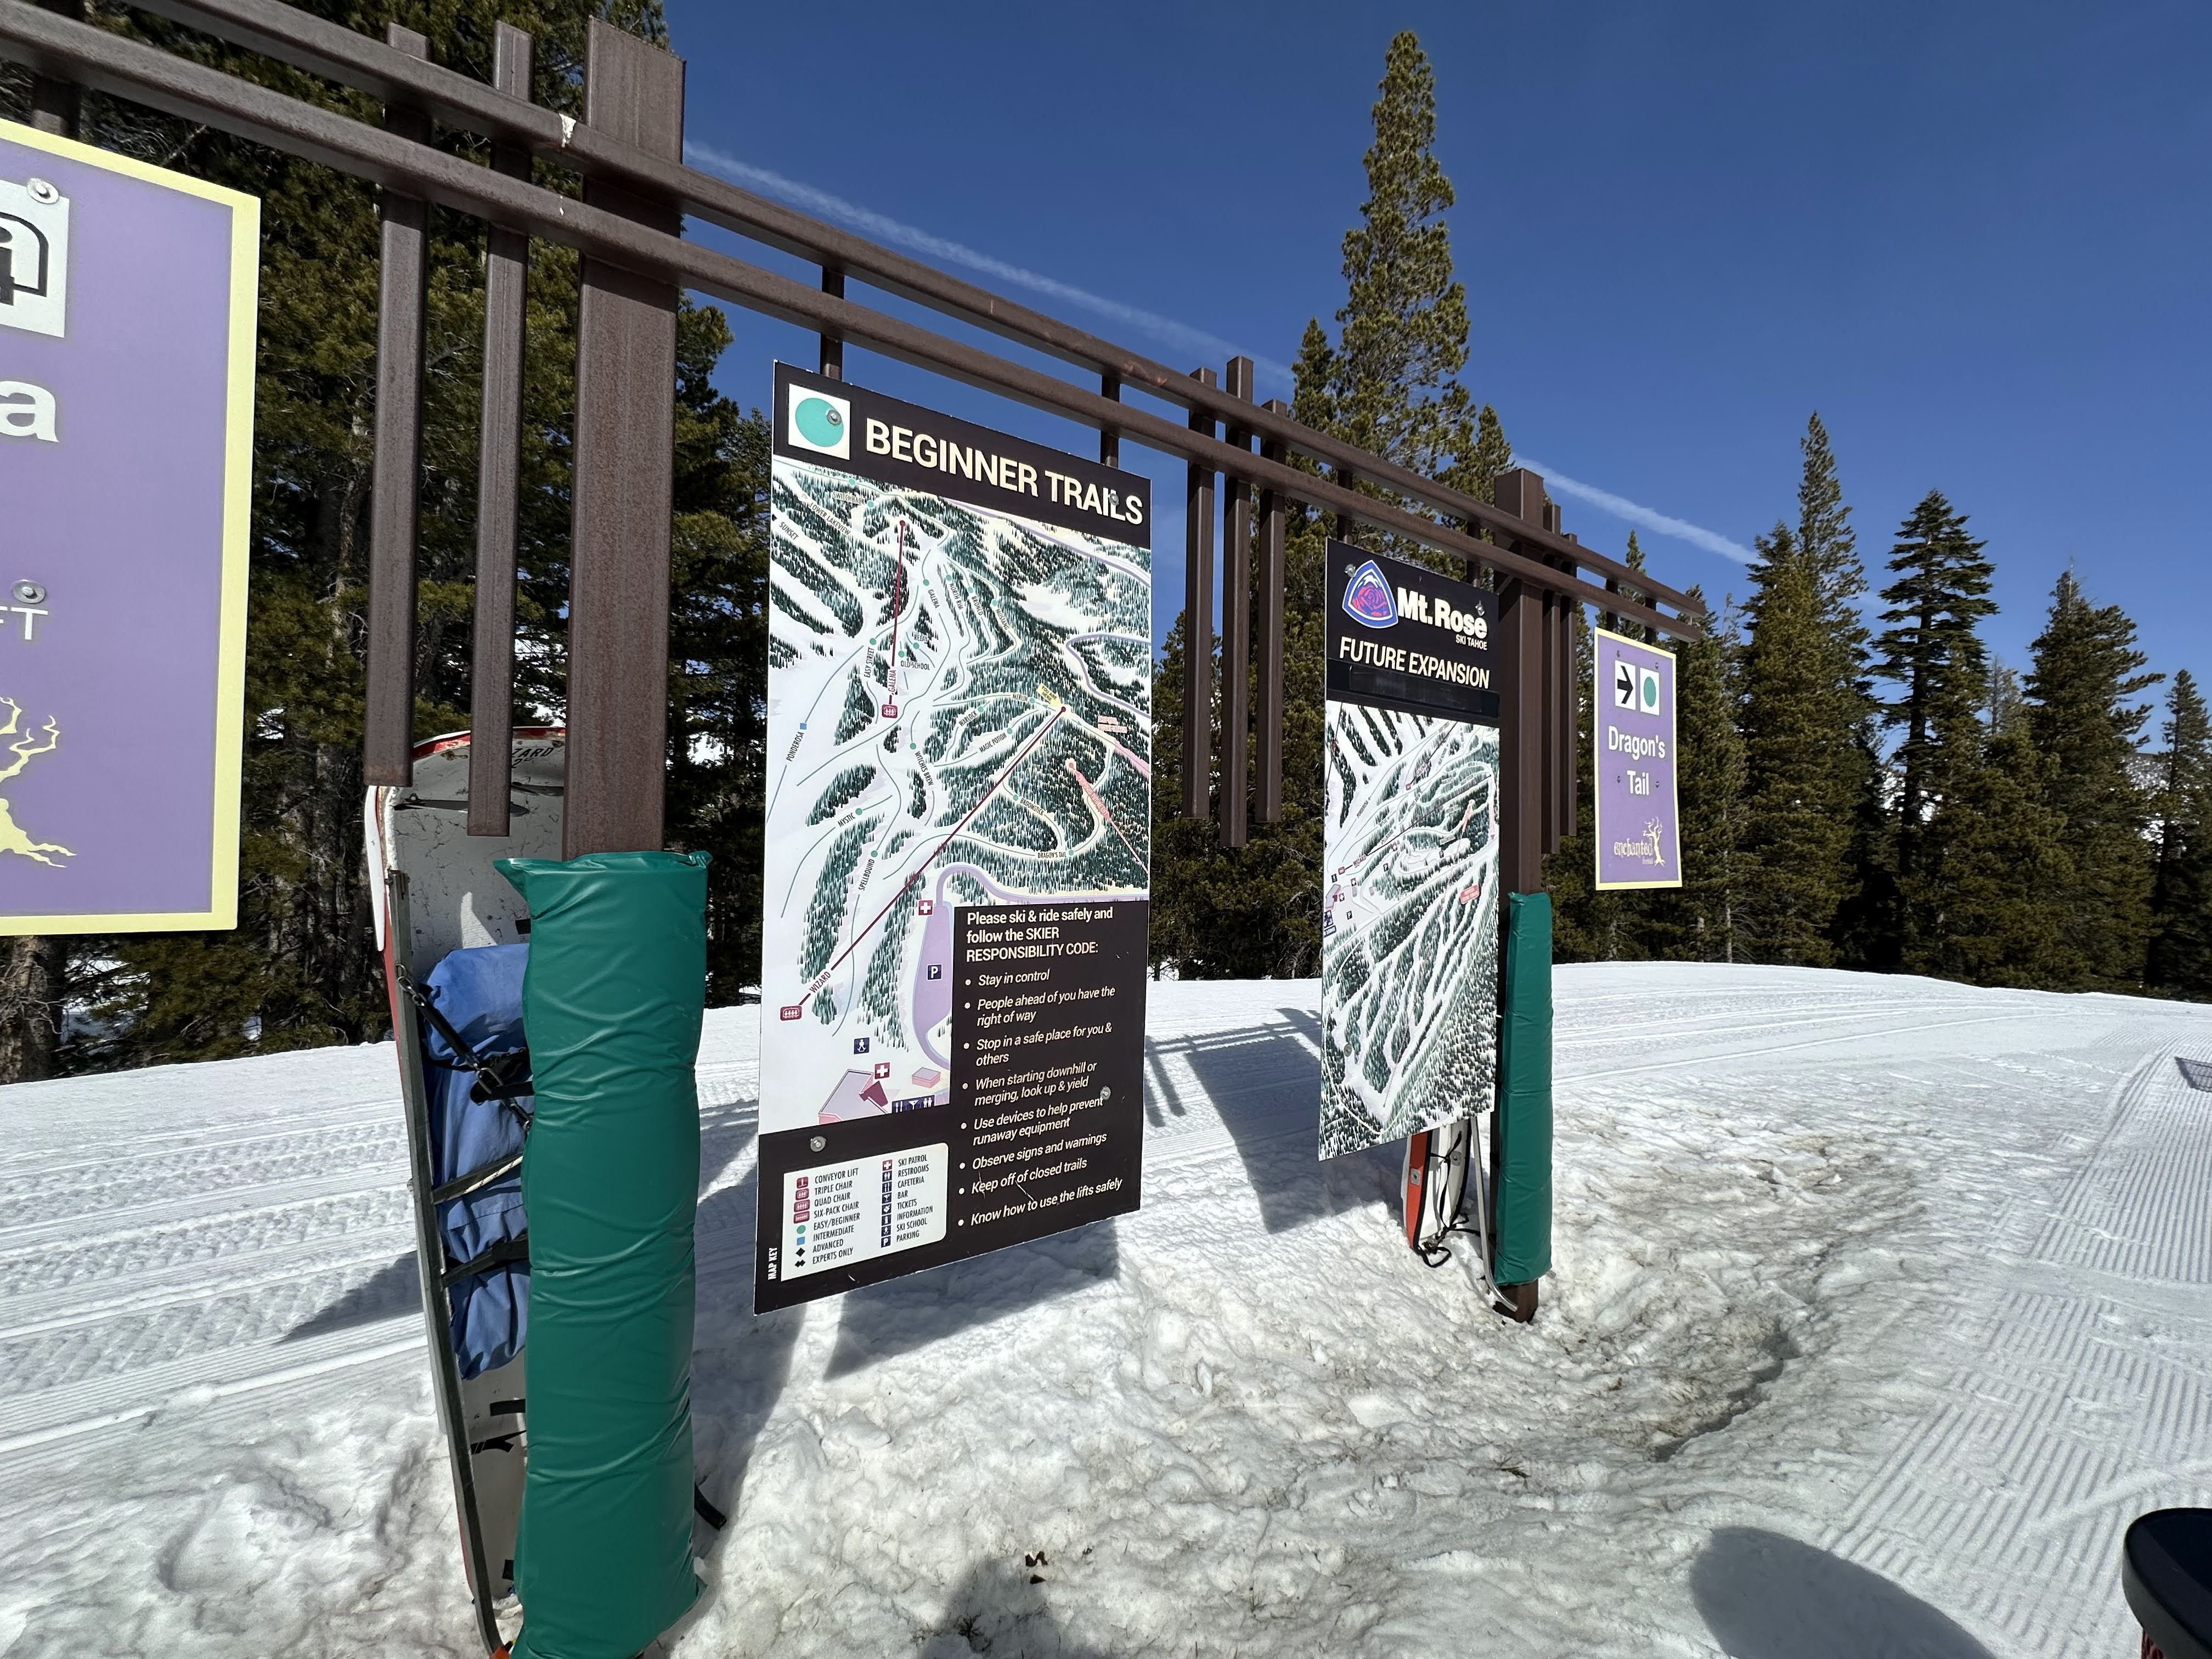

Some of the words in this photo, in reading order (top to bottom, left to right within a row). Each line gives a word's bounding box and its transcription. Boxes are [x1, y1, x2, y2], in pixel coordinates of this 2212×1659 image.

[866, 417, 1038, 497] BEGINNER
[1045, 470, 1143, 525] TRAILS
[833, 491, 865, 504] SWITCHBACK
[810, 503, 827, 518] LOWER
[826, 516, 851, 535] LAKEVIEW
[779, 522, 799, 540] SUNSET
[928, 589, 940, 608] GALENA
[950, 583, 958, 600] NORTH
[971, 595, 983, 616] BRONCO
[996, 608, 1009, 630] MUSTANG
[1455, 634, 1466, 645] SKI
[1468, 636, 1487, 651] TAHOE
[866, 647, 874, 664] STREET
[1340, 636, 1406, 671] FUTURE
[1408, 652, 1489, 689] EXPANSION
[911, 661, 930, 670] SCHOOL
[888, 670, 896, 692] GALENA
[958, 710, 978, 727] WARLOCK
[786, 732, 804, 762] PONDEROSA
[979, 740, 993, 753] MAGIC
[991, 733, 1007, 745] POTION
[1609, 725, 1666, 760] Dragon's
[511, 747, 554, 757] ZARD
[915, 751, 928, 773] WITCHES
[924, 771, 933, 786] BREW
[1627, 770, 1649, 795] Tail
[1020, 798, 1044, 816] BROOMSTICK
[837, 812, 855, 827] MYSTIC
[1614, 838, 1653, 858] enchanted
[859, 859, 874, 891] SPELLBOUND
[967, 911, 1006, 925] Please
[1009, 910, 1025, 923] ski
[1028, 910, 1036, 922] &
[1039, 909, 1059, 921] ride
[1062, 907, 1092, 922] safely
[1094, 907, 1113, 919] and
[967, 930, 1003, 944] follow
[1005, 929, 1023, 941] the
[1026, 927, 1059, 940] SKIER
[966, 944, 1063, 962] RESPONSIBILITY
[1066, 942, 1098, 955] CODE:
[809, 971, 831, 993] WIZARD
[978, 974, 1002, 988] Stay
[1004, 972, 1013, 984] in
[1015, 969, 1050, 983] control
[978, 996, 1013, 1011] People
[1015, 992, 1046, 1007] ahead
[1047, 991, 1058, 1002] of
[1059, 992, 1076, 1005] you
[1077, 988, 1099, 1000] have
[1101, 986, 1115, 998] the
[977, 1014, 1001, 1028] right
[1003, 1011, 1015, 1023] of
[1016, 1011, 1036, 1023] way
[977, 1038, 1001, 1050] Stop
[1003, 1035, 1012, 1047] in
[1014, 1036, 1020, 1045] a
[1023, 1031, 1044, 1044] safe
[1045, 1029, 1071, 1043] place
[1073, 1026, 1087, 1037] for
[1087, 1026, 1104, 1039] you
[1105, 1022, 1112, 1032] &
[976, 1053, 1009, 1066] others
[975, 1077, 1005, 1090] When
[1007, 1070, 1045, 1085] starting
[1046, 1062, 1086, 1079] downhill
[1087, 1062, 1097, 1071] or
[974, 1089, 1019, 1106] merging,
[1021, 1085, 1042, 1098] look
[1044, 1084, 1057, 1094] up
[1058, 1080, 1065, 1091] &
[1067, 1076, 1088, 1093] yield
[974, 1119, 994, 1130] Use
[996, 1110, 1034, 1126] devices
[1036, 1108, 1046, 1118] to
[1047, 1103, 1068, 1116] help
[1069, 1097, 1103, 1113] prevent
[973, 1129, 1017, 1146] runaway
[1019, 1117, 1070, 1137] equipment
[972, 1152, 1014, 1170] Observe
[1017, 1145, 1043, 1161] signs
[1045, 1139, 1063, 1154] and
[1065, 1132, 1107, 1149] warnings
[898, 1158, 907, 1167] SKI
[909, 1154, 927, 1165] PATROL
[815, 1170, 846, 1184] CONVEYOR
[847, 1167, 859, 1177] LIFT
[898, 1164, 929, 1178] RESTROOMS
[972, 1180, 998, 1194] Keep
[1000, 1172, 1016, 1187] off
[1017, 1170, 1029, 1183] of
[1029, 1163, 1063, 1180] closed
[1064, 1157, 1087, 1171] trails
[815, 1184, 834, 1195] TRIPLE
[836, 1181, 853, 1192] CHAIR
[898, 1176, 924, 1188] CAFETERIA
[814, 1197, 831, 1207] QUAD
[833, 1192, 851, 1203] CHAIR
[898, 1190, 908, 1199] BAR
[970, 1209, 1003, 1226] Know
[1003, 1201, 1025, 1217] how
[1028, 1200, 1037, 1211] to
[1040, 1195, 1058, 1206] use
[1059, 1189, 1075, 1202] the
[1076, 1184, 1094, 1198] lifts
[1095, 1177, 1122, 1193] safely
[814, 1205, 841, 1218] SIX-PACK
[842, 1201, 859, 1213] CHAIR
[897, 1199, 917, 1210] TICKETS
[897, 1205, 933, 1221] INFORMATION
[814, 1212, 860, 1231] EASY/BEGINNER
[896, 1222, 905, 1232] SKI
[906, 1217, 927, 1229] SCHOOL
[813, 1224, 854, 1242] INTERMEDIATE
[896, 1230, 919, 1243] PARKING
[769, 1246, 778, 1263] KEY
[812, 1239, 844, 1253] ADVANCED
[812, 1252, 837, 1264] EXPERTS
[838, 1247, 853, 1259] ONLY
[768, 1263, 777, 1280] MAP
